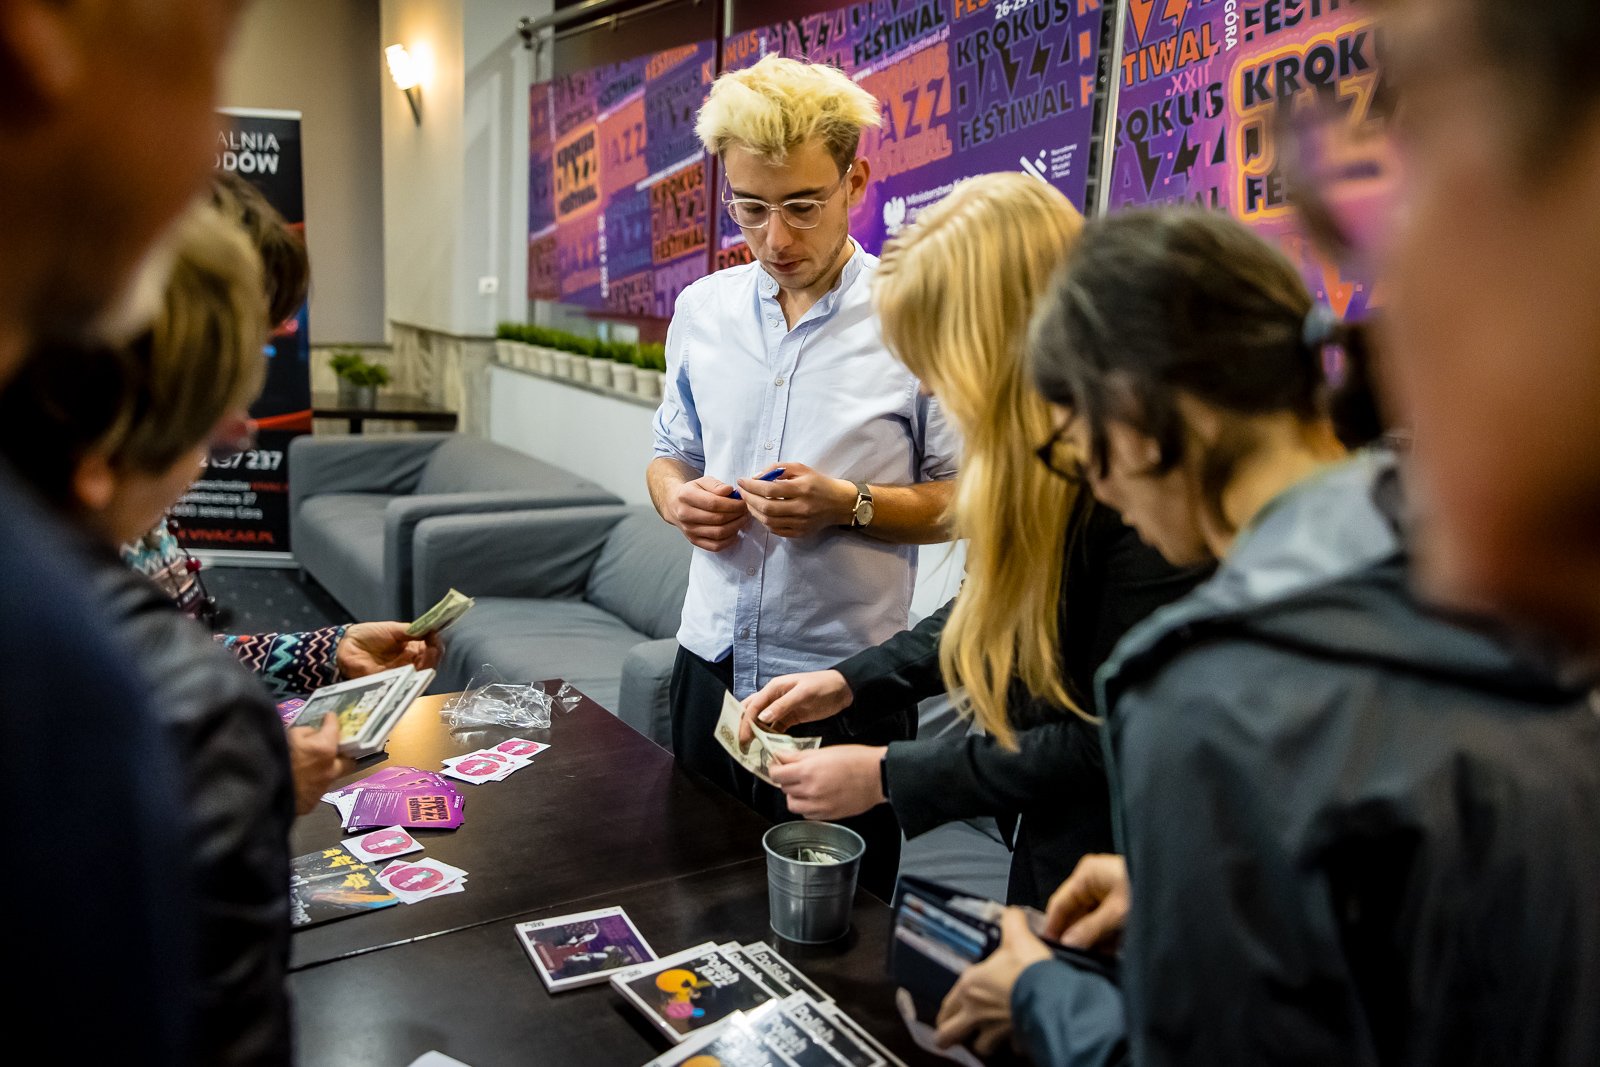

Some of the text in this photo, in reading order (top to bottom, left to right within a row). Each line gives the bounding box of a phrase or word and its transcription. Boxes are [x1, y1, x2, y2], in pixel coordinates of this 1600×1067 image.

[853, 0, 945, 67] FESTIWAL
[956, 0, 1070, 69] KROKUS
[1223, 0, 1239, 51] GÓRA
[957, 81, 1076, 151] FESTIWAL
